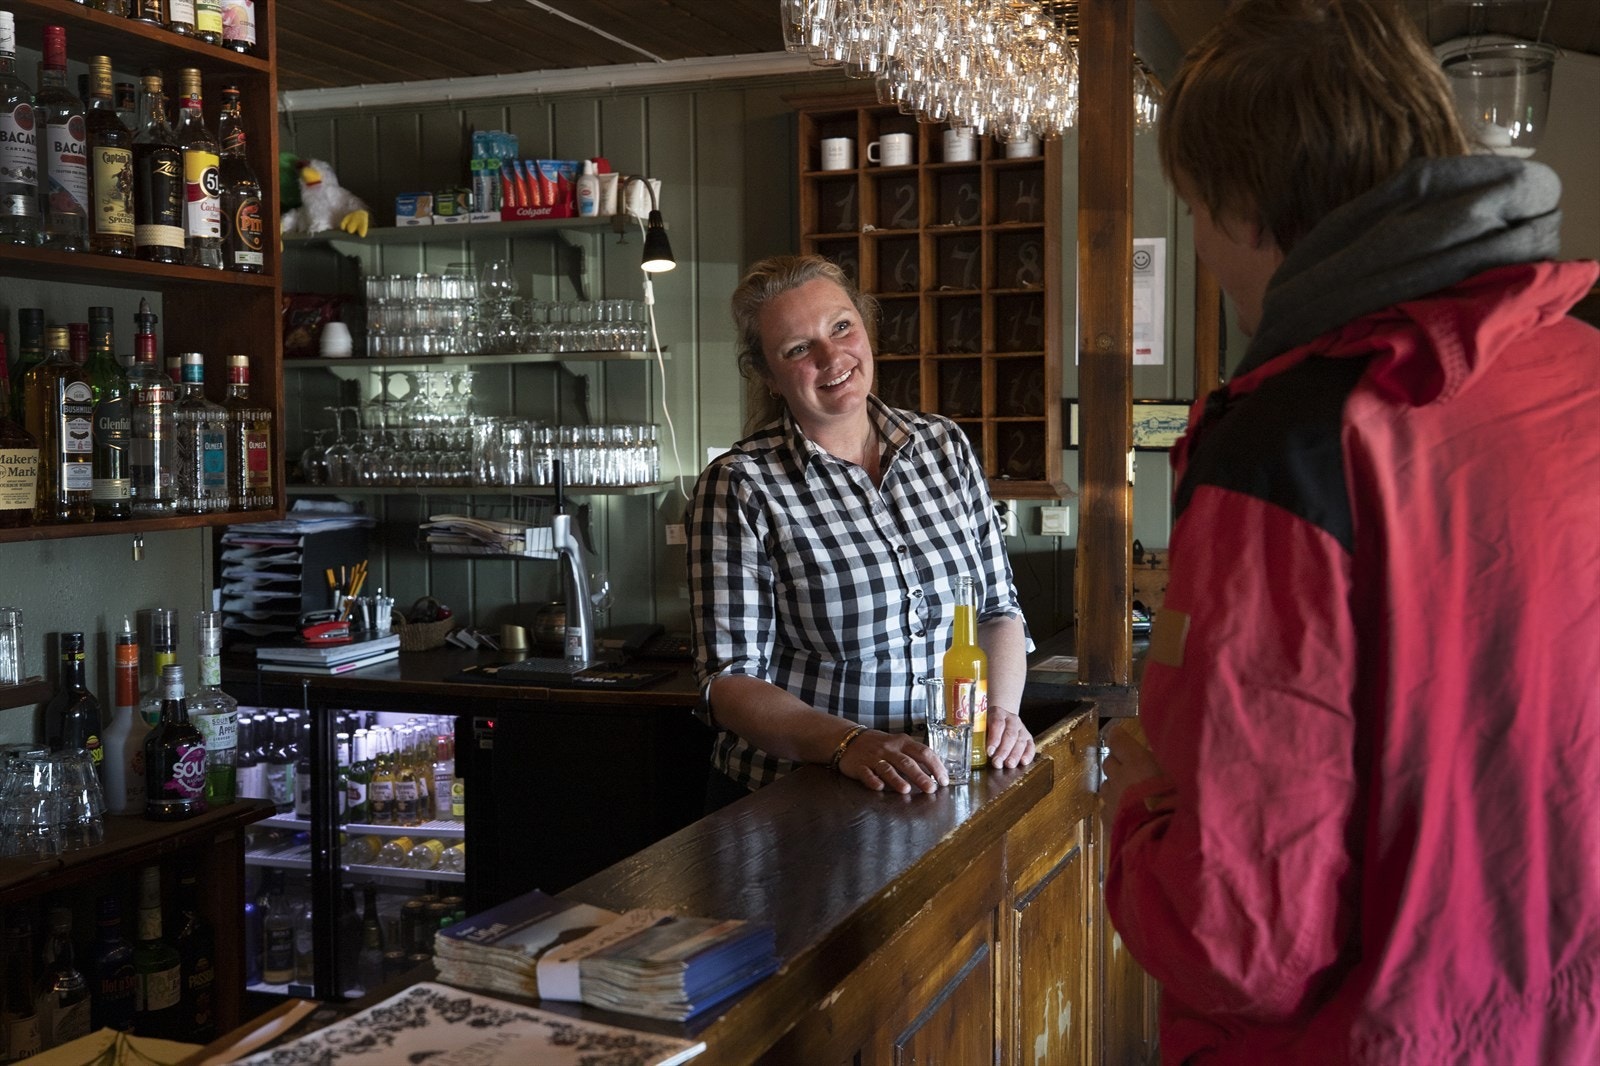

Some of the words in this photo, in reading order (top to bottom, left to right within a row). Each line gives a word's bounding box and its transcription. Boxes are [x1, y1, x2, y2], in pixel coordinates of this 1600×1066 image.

[206, 173, 218, 190] 51
[1014, 180, 1039, 222] 4
[516, 207, 552, 217] Colgate
[835, 184, 855, 230] 1
[892, 184, 918, 228] 2
[955, 184, 979, 226] 3
[894, 249, 918, 289] 6
[951, 244, 981, 289] 7
[1015, 241, 1041, 285] 8
[248, 441, 267, 449] OLMECA
[7, 466, 37, 477] Mark
